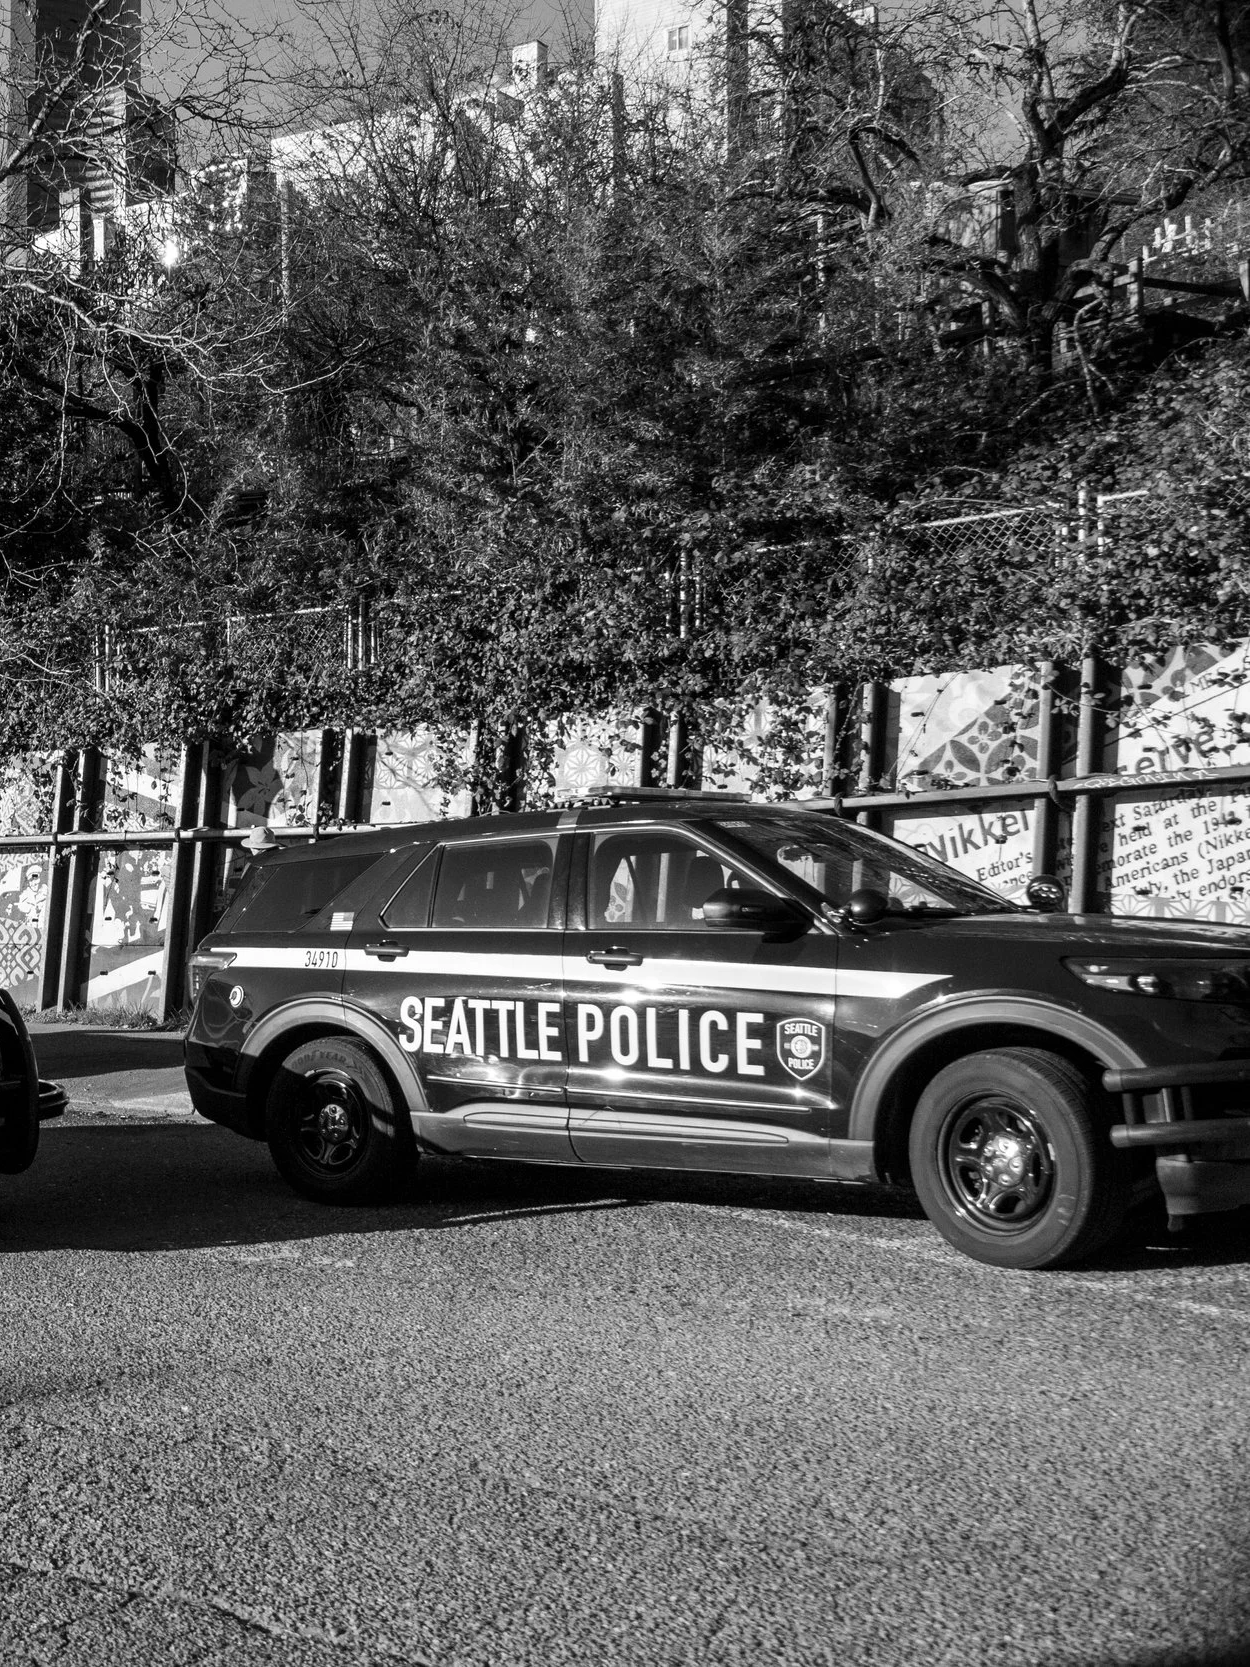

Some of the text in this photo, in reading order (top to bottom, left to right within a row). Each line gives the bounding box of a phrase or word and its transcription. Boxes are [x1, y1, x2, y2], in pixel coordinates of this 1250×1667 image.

[1163, 813, 1180, 829] at
[1190, 800, 1217, 819] the
[1168, 829, 1193, 847] the
[977, 852, 1033, 882] Editor's
[1104, 852, 1188, 891] Americans
[1173, 868, 1199, 885] the
[305, 951, 338, 969] 34910
[399, 996, 765, 1076] SEATTLE POLICE
[784, 1023, 818, 1037] SEATTLE
[788, 1057, 814, 1070] POLICE
